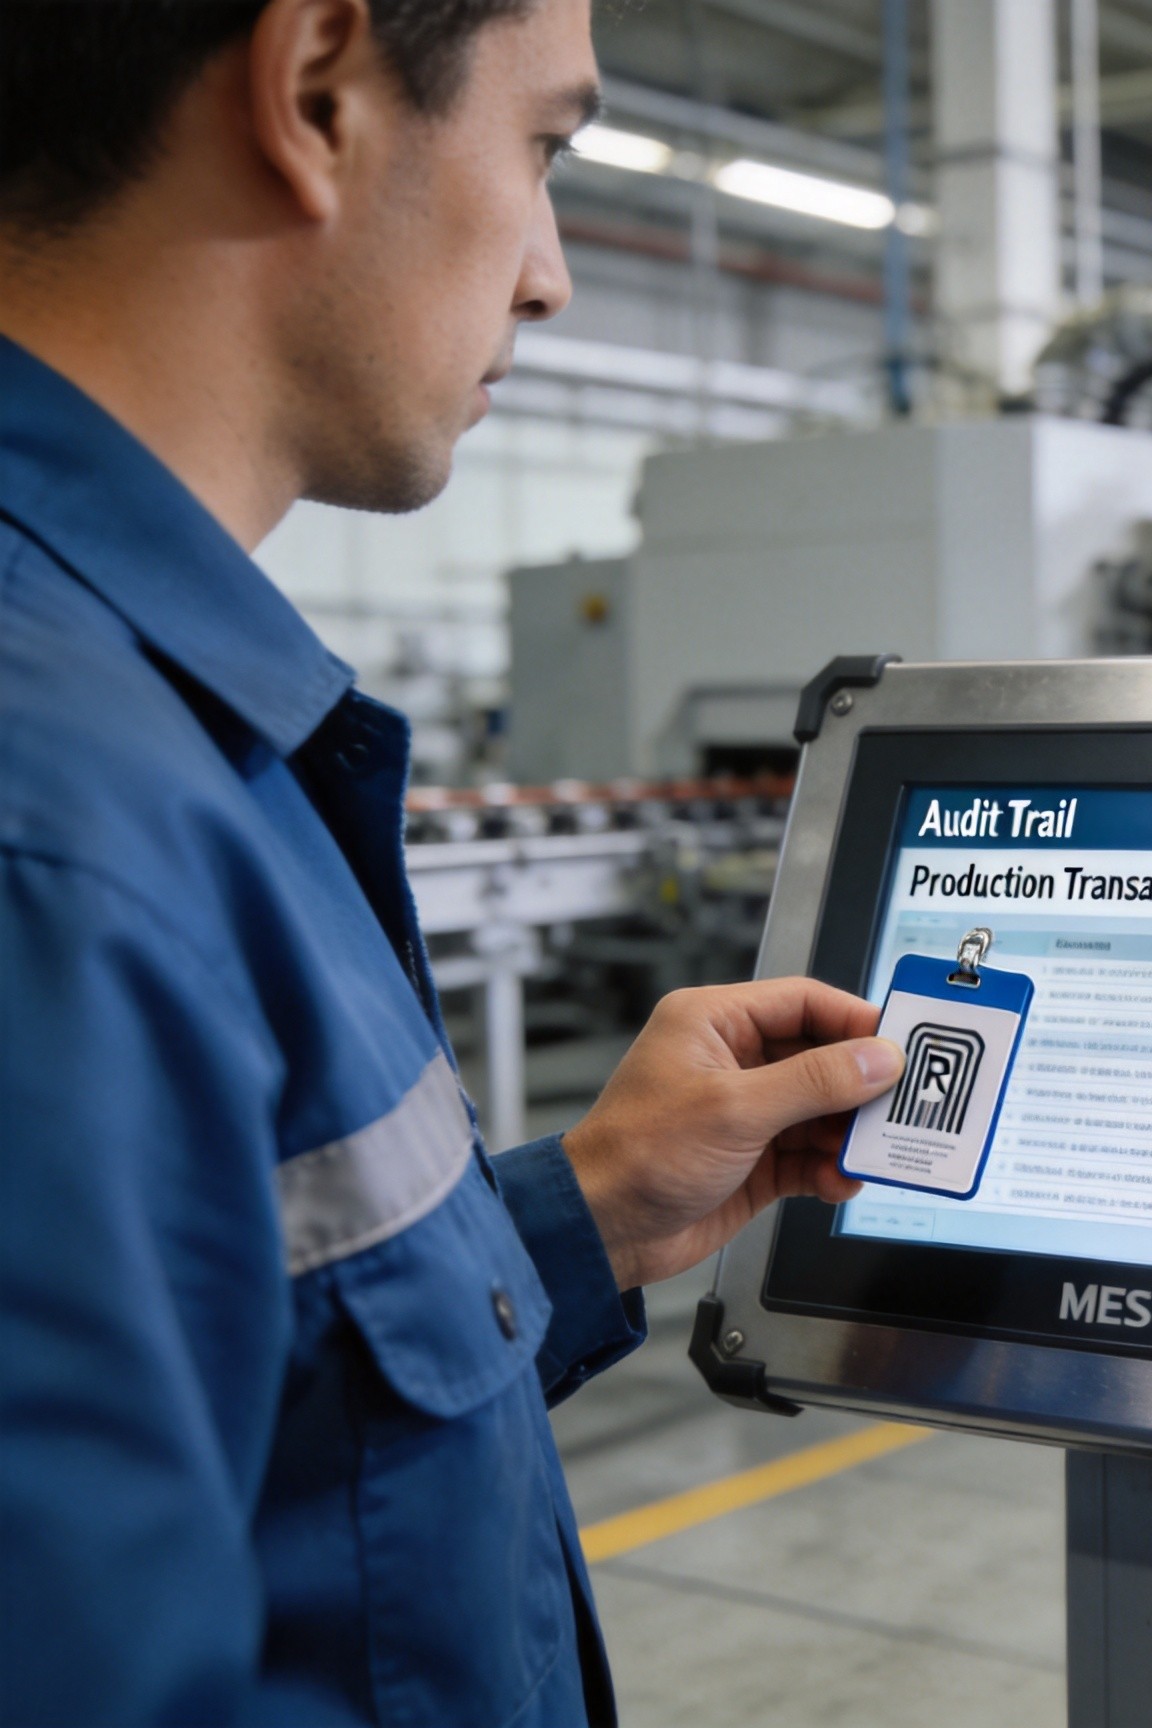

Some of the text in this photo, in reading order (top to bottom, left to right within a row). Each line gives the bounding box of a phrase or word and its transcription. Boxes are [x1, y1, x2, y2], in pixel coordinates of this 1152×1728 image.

[918, 798, 1077, 839] Audit Trail
[909, 863, 1054, 899] Production
[922, 1053, 950, 1095] R
[1059, 1282, 1152, 1328] MES
